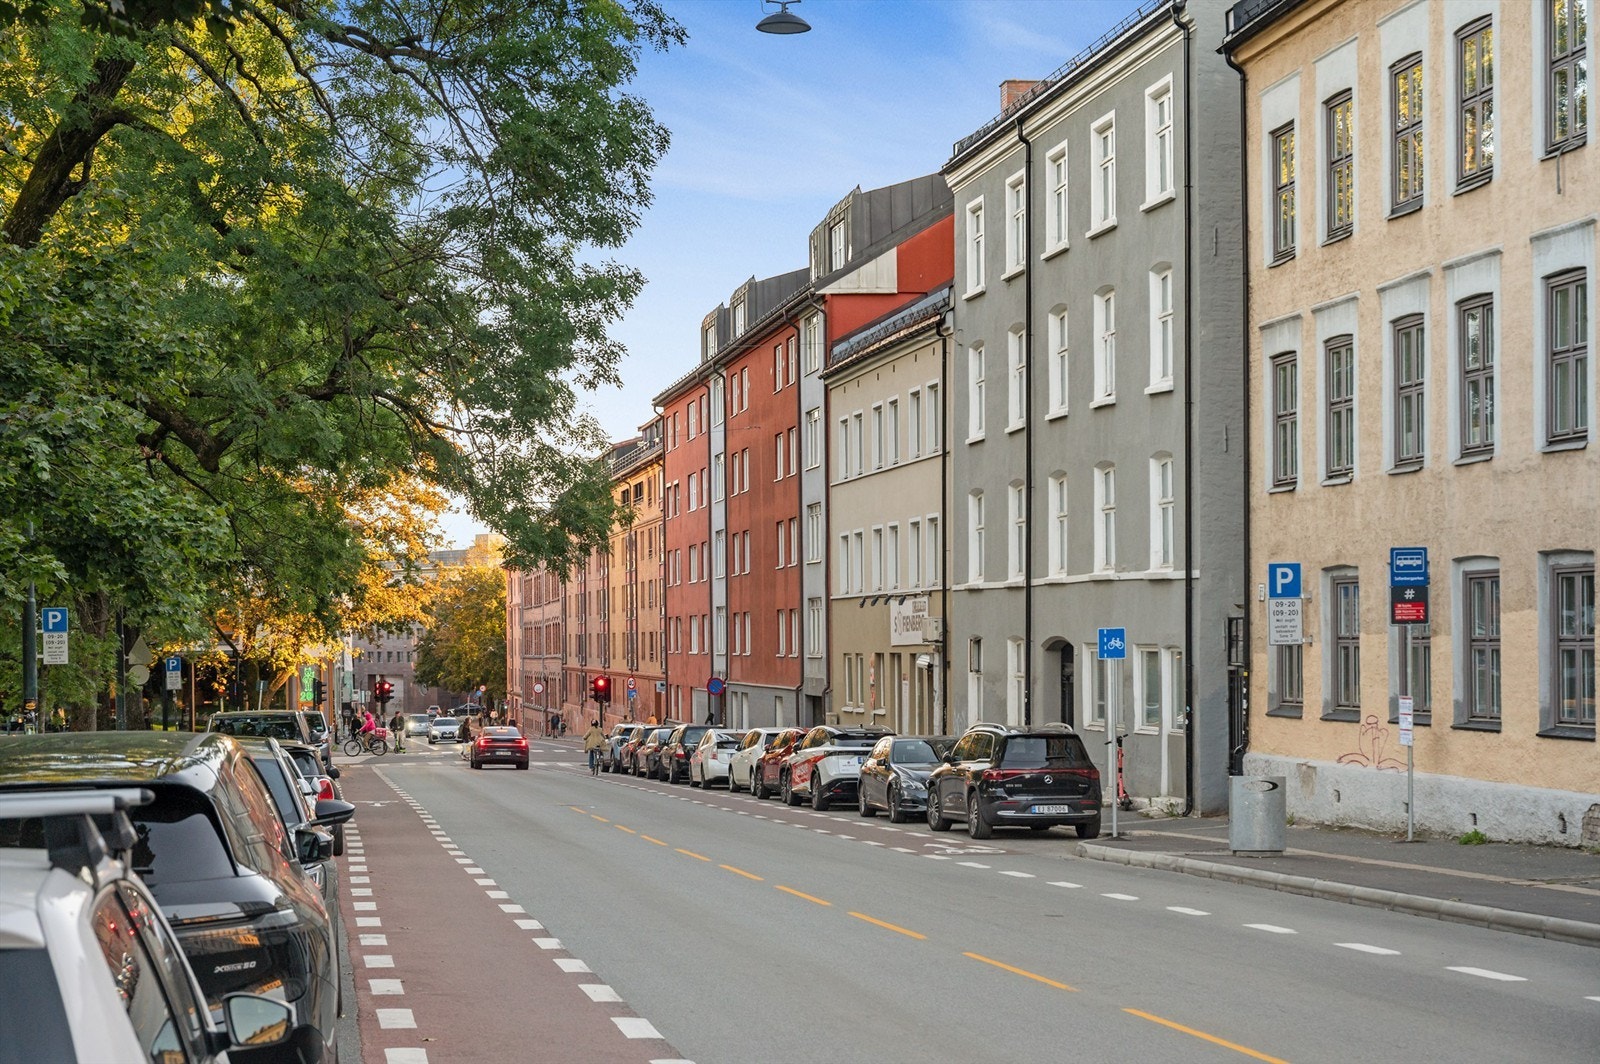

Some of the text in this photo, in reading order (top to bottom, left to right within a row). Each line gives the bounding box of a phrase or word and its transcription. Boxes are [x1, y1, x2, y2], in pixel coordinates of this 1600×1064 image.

[1276, 567, 1294, 594] P
[48, 611, 62, 630] P
[169, 659, 177, 670] P
